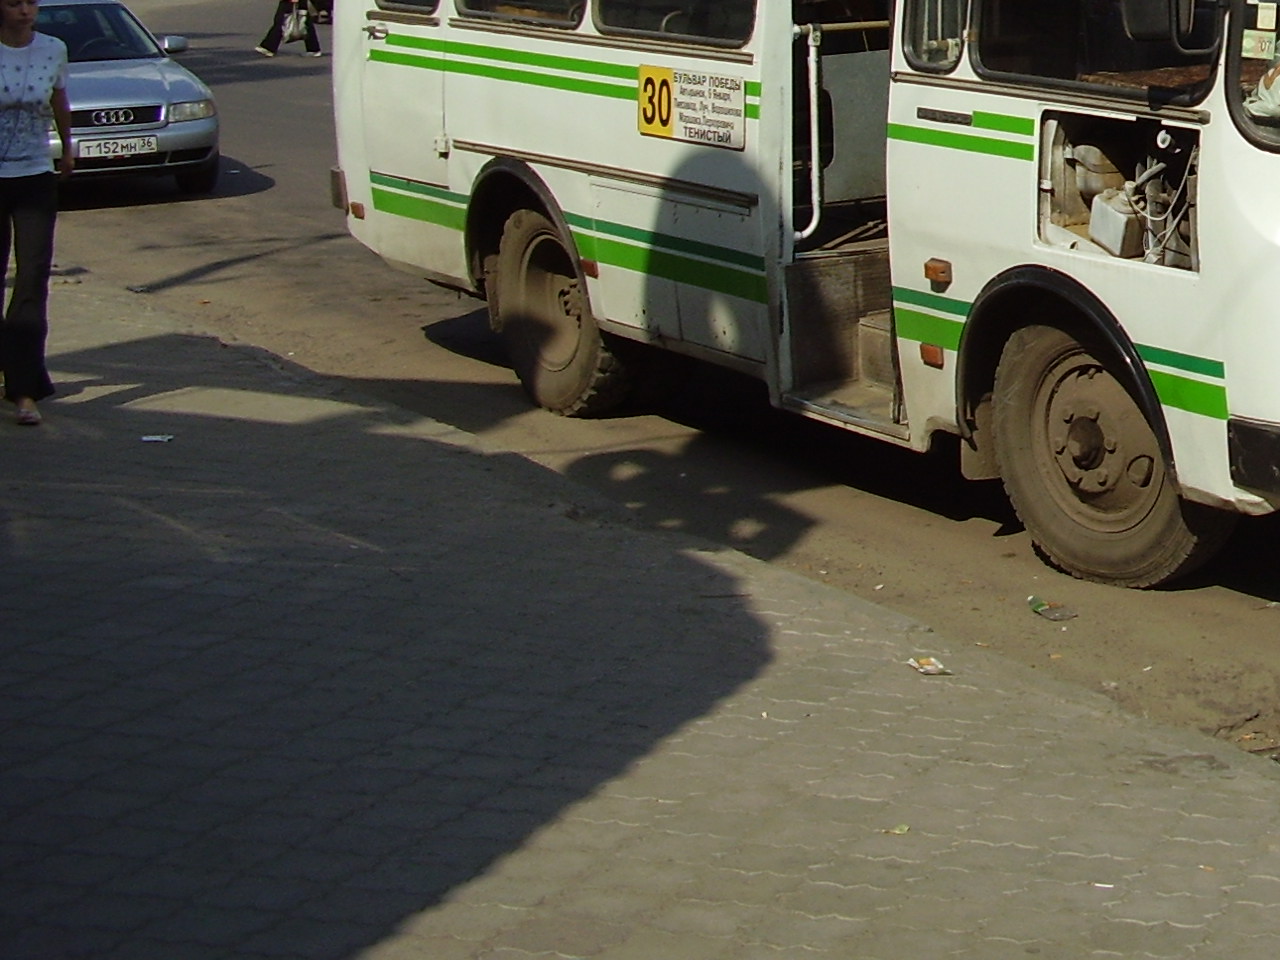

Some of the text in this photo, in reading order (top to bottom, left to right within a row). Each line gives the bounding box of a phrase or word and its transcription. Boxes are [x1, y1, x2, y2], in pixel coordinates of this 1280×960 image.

[642, 72, 741, 128] 30 БУЛЬВАР ПОБЕДЫ
[141, 138, 153, 148] 36
[683, 126, 731, 144] ТЕНИСТЫЙ
